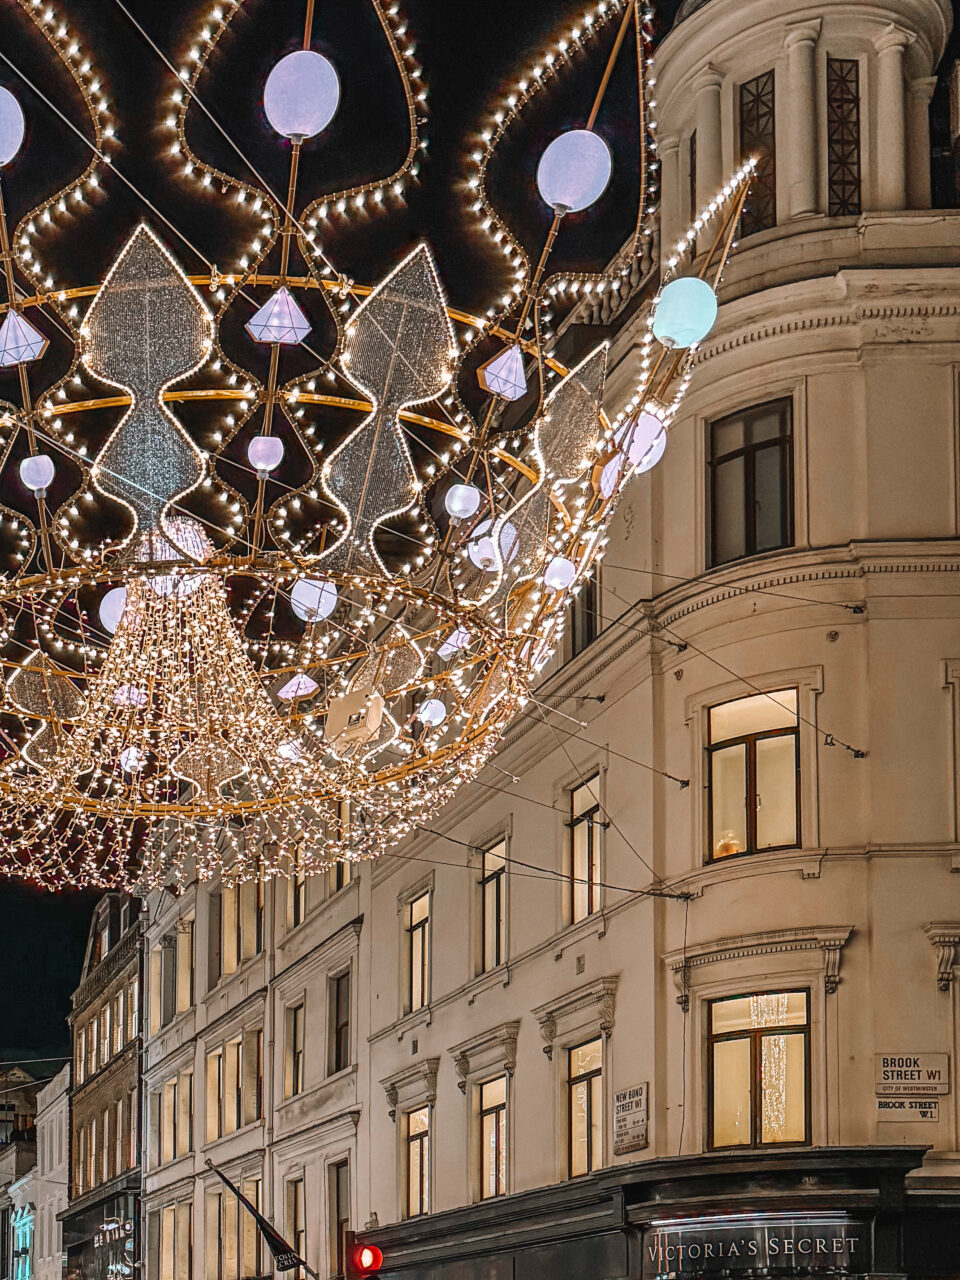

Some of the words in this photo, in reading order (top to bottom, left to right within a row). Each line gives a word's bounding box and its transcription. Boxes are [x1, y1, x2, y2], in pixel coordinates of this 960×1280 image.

[882, 1057, 920, 1068] BROOK
[882, 1070, 922, 1080] STREET
[926, 1070, 941, 1080] W1
[615, 1091, 628, 1104] NEW
[628, 1087, 643, 1100] BOND
[615, 1100, 634, 1115] STREET
[634, 1098, 642, 1109] W1
[878, 1101, 906, 1109] BROOK
[908, 1101, 939, 1109] STREET
[648, 1239, 758, 1262] VICTORIA'S
[768, 1237, 859, 1255] SECRET
